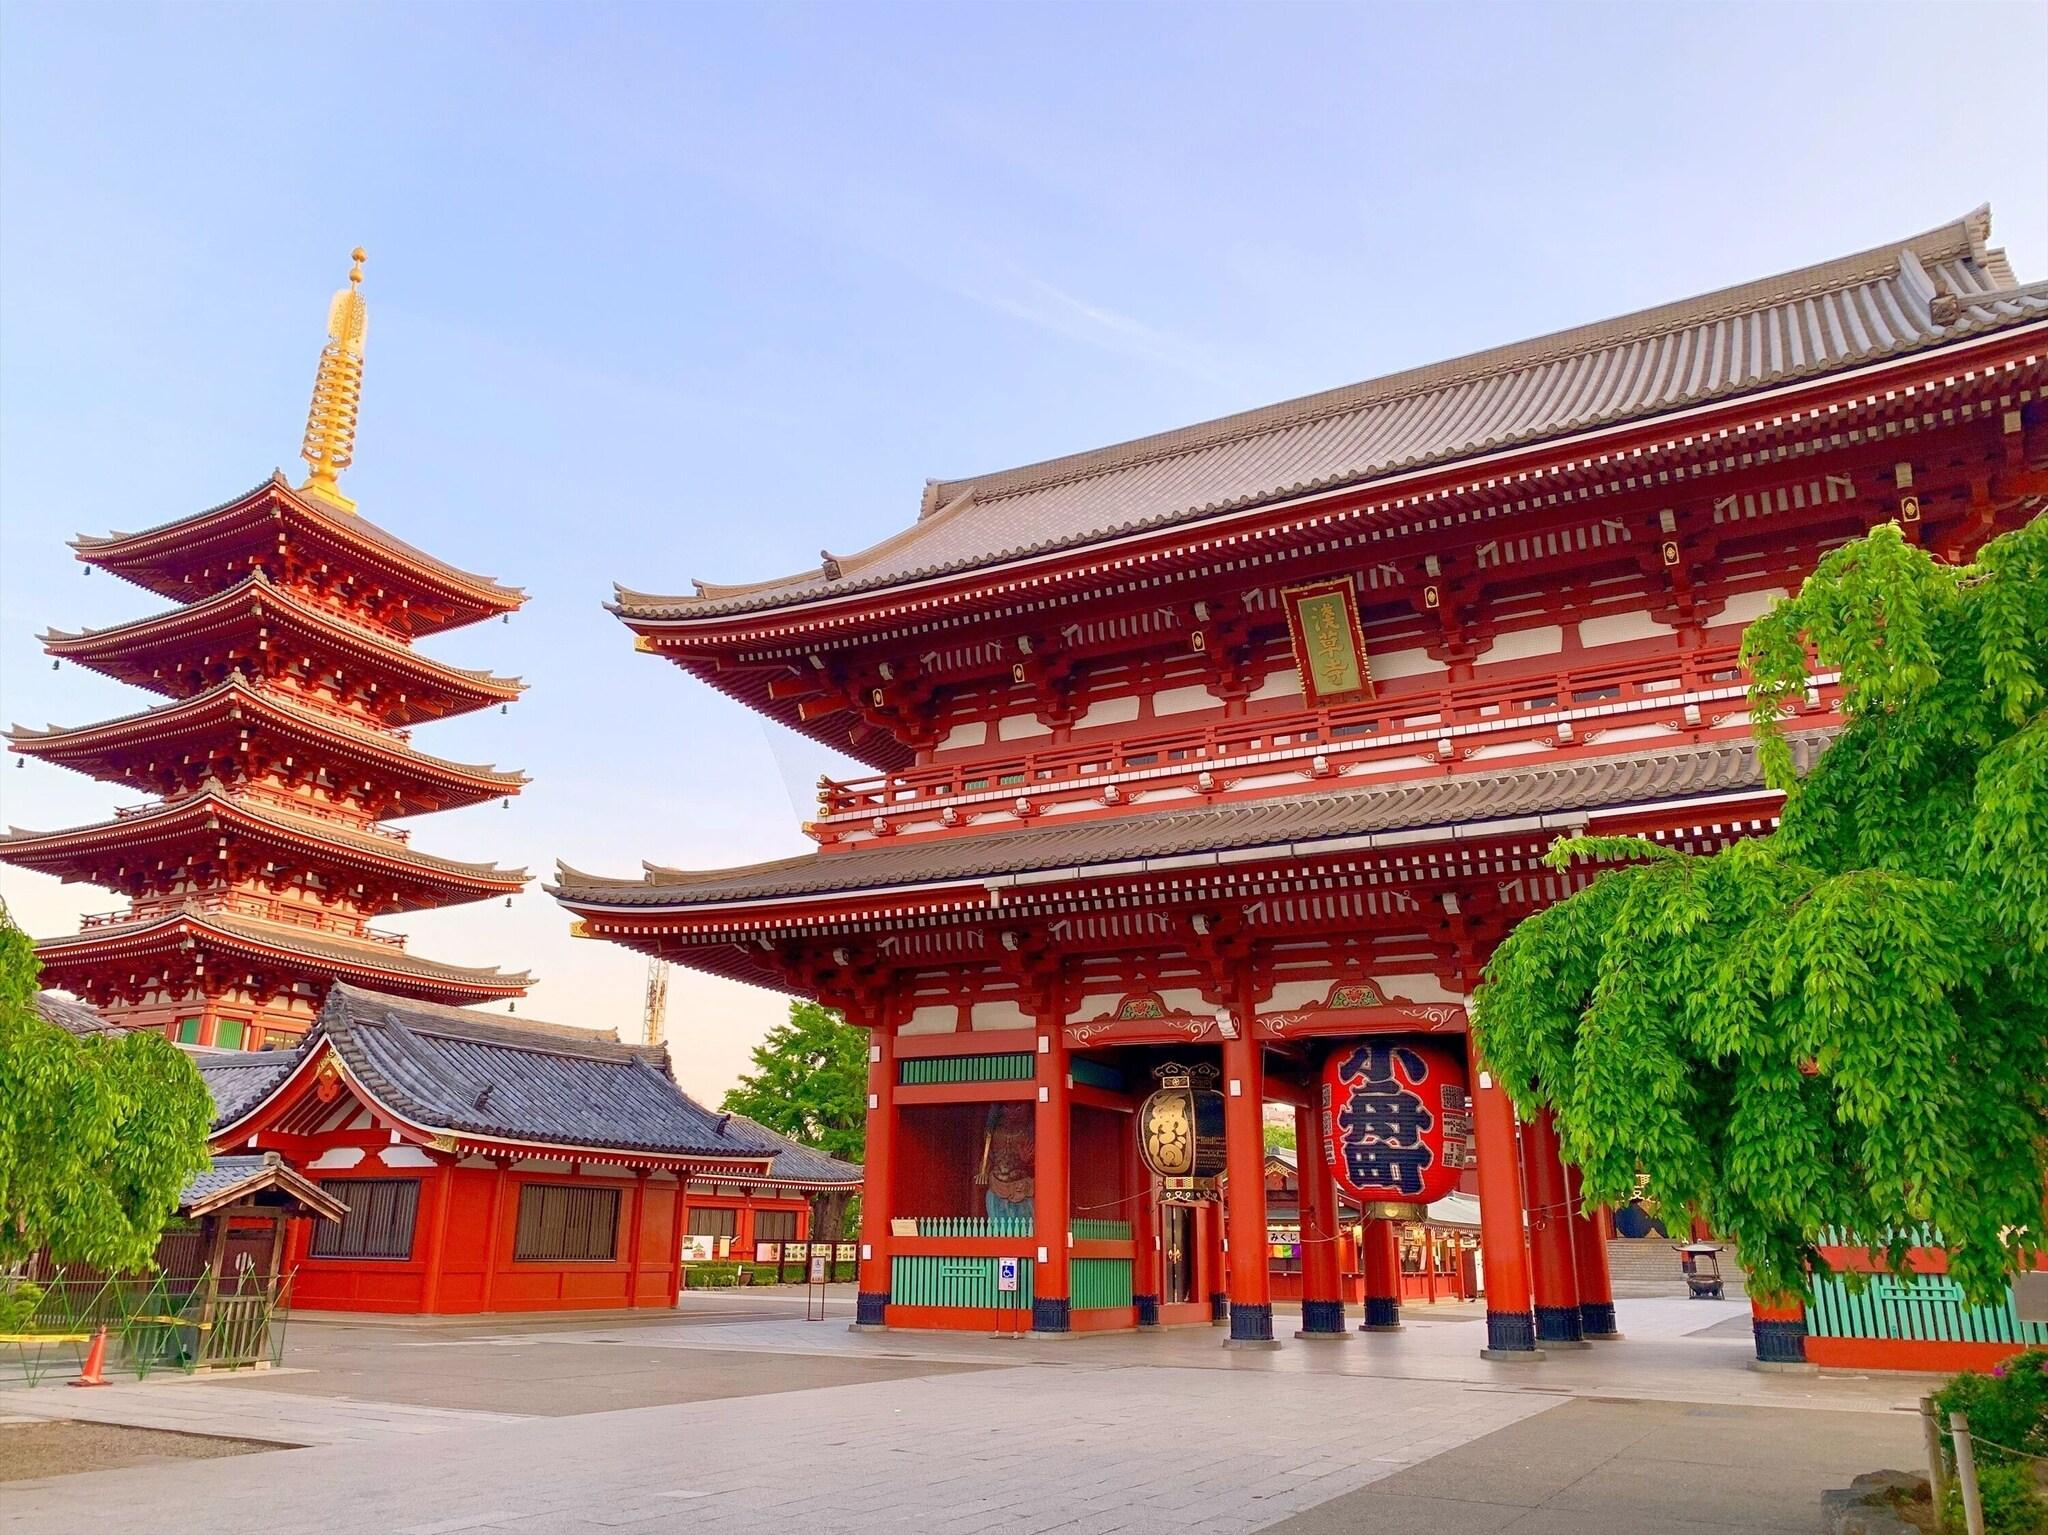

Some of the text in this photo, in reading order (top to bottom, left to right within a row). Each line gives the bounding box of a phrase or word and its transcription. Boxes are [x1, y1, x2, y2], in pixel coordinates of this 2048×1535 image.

[1339, 1046, 1434, 1194] 小舟町
[1271, 1233, 1297, 1241] みくじ
